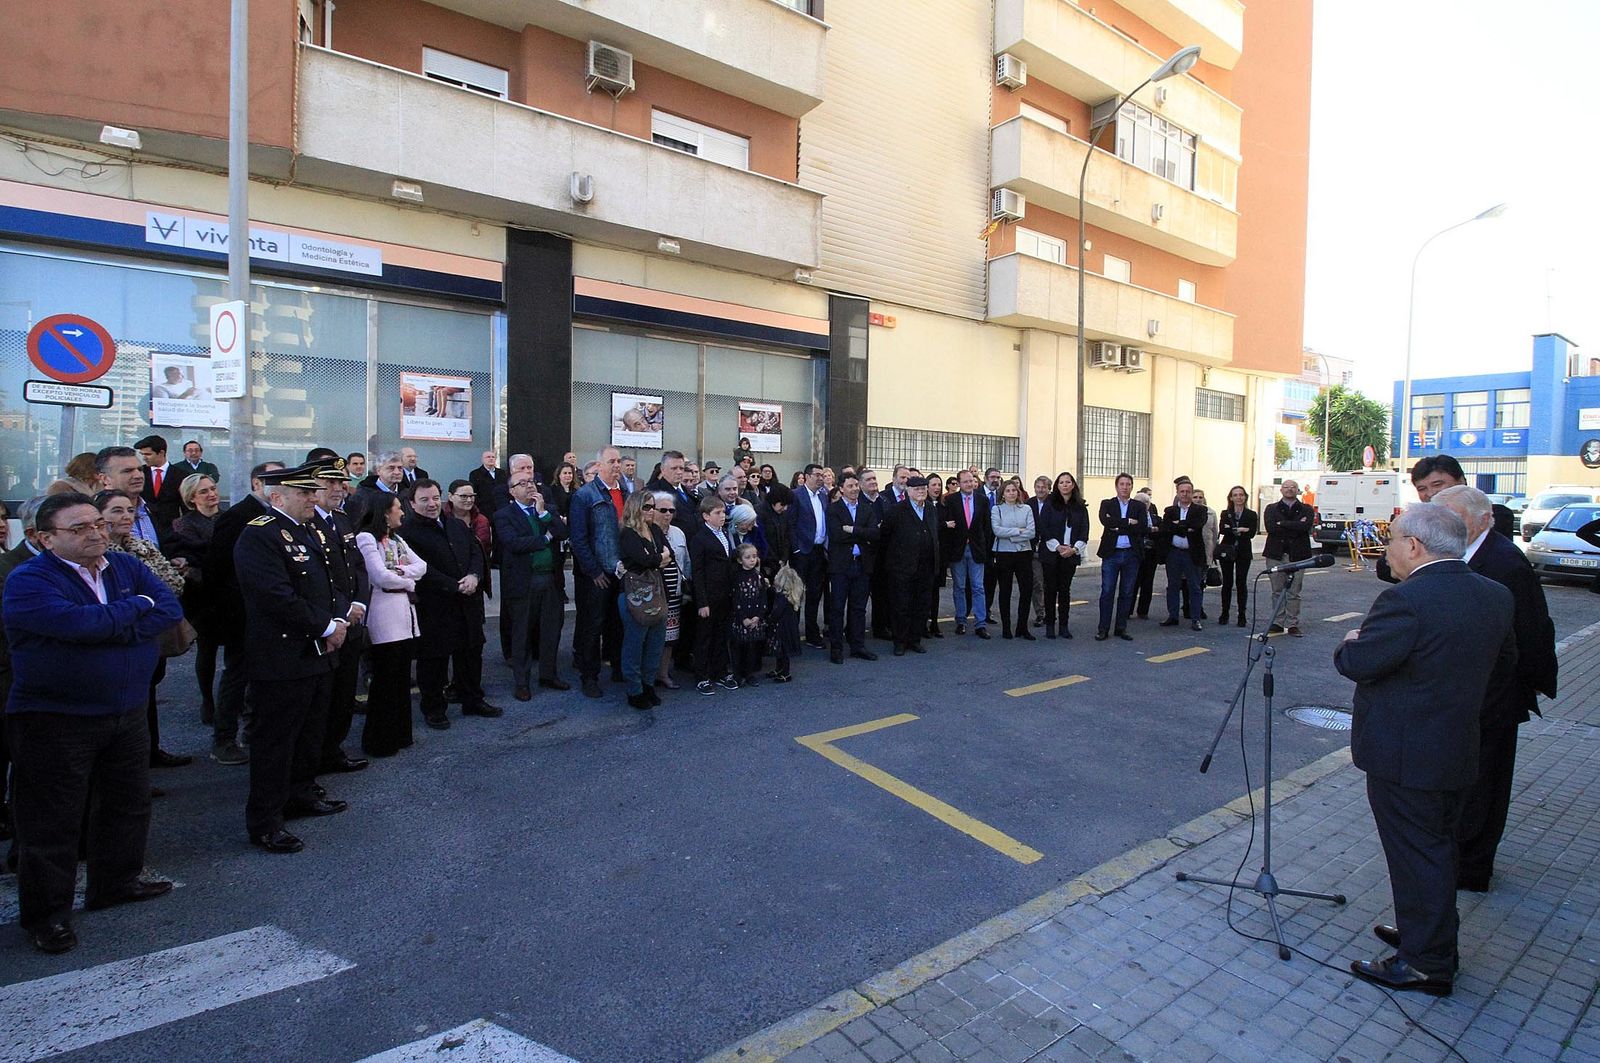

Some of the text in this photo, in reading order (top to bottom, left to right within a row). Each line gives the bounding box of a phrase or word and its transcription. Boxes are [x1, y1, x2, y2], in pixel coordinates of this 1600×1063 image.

[195, 227, 279, 254] vivnta
[301, 242, 355, 258] Odontología y
[301, 252, 370, 269] Medicina Estética
[158, 400, 188, 408] Recupera
